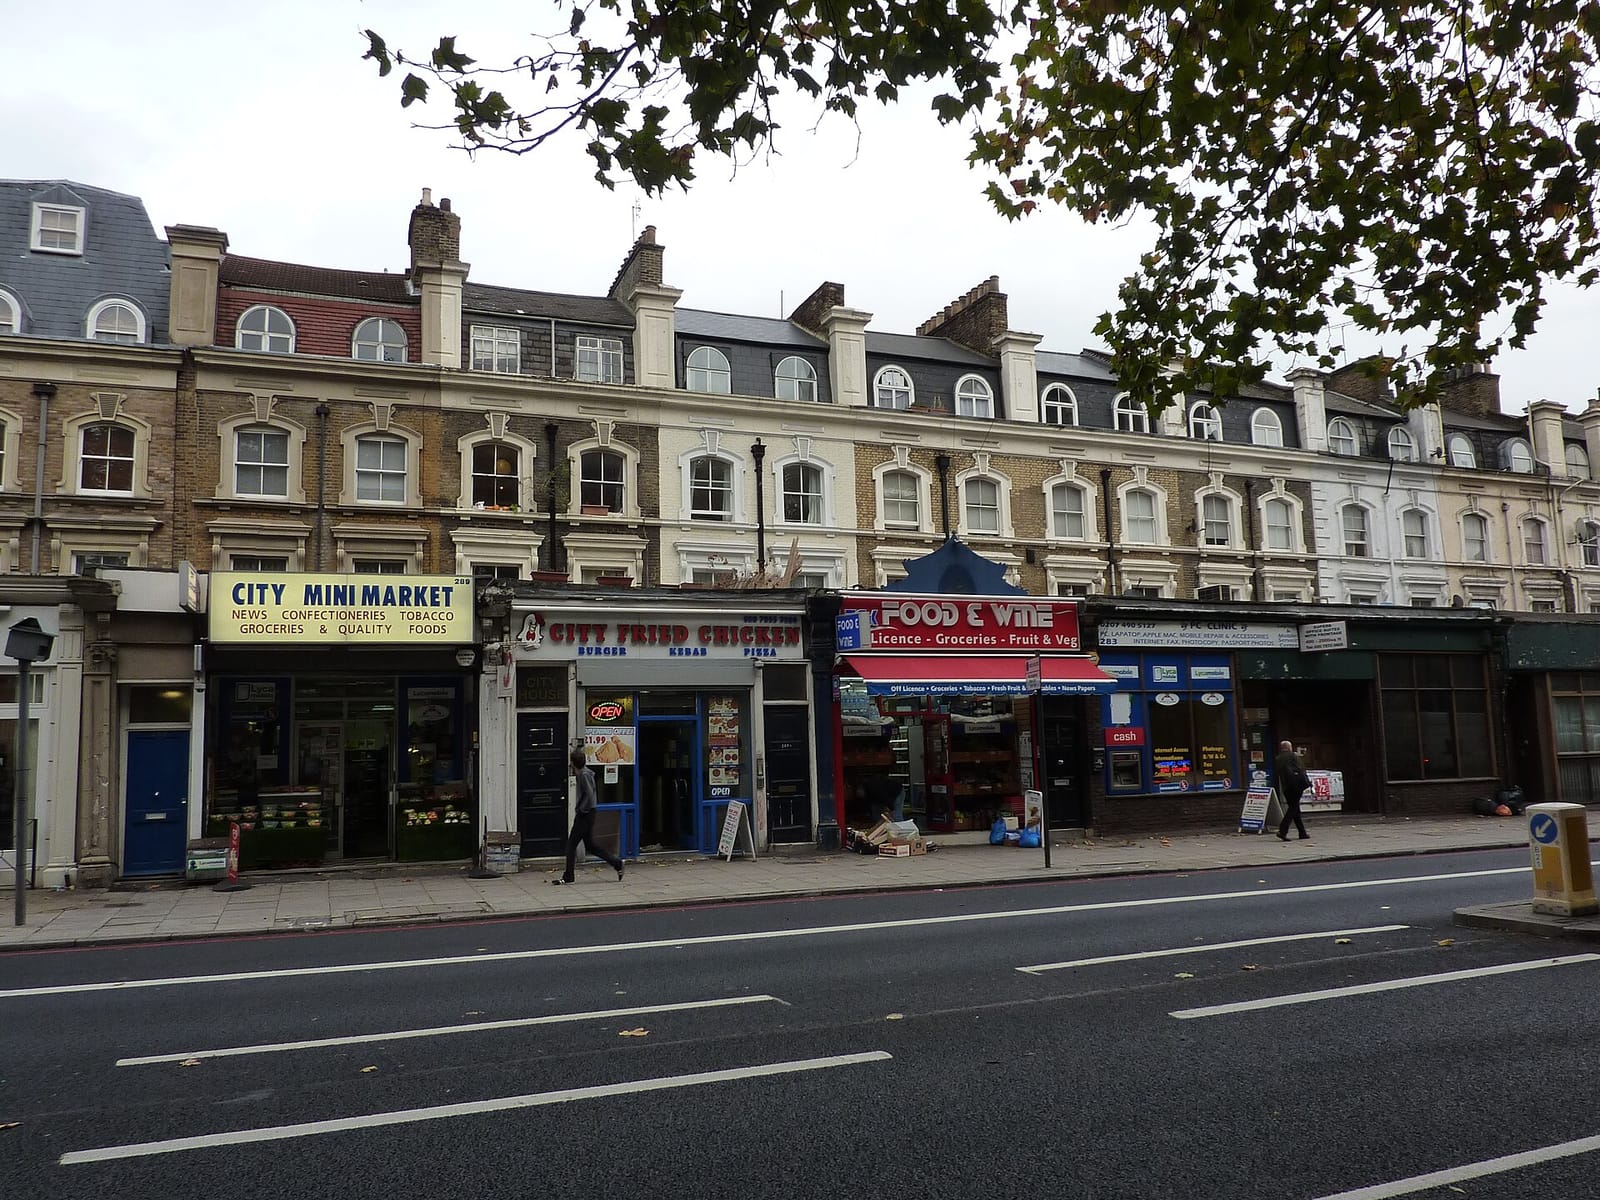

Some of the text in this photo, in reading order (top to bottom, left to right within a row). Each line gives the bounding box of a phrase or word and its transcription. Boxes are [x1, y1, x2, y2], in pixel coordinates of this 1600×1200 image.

[231, 582, 454, 607] CITY MINI MARKET
[232, 609, 454, 621] NEWS CONFECTIONERIES TOBACCO
[881, 601, 959, 626] FOOD
[240, 623, 447, 635] GROCERIES & QUALITY FOODS
[837, 619, 854, 631] FOOD
[1207, 622, 1238, 630] CLINIC
[549, 623, 801, 645] CITY FRIED CHICKEN
[870, 632, 921, 644] Licence
[935, 633, 997, 644] Groceries
[1009, 634, 1040, 645] Fruit
[1042, 634, 1052, 645] &
[1055, 634, 1078, 648] Veg
[577, 646, 627, 656] BURGER
[669, 647, 707, 657] KEBAB
[743, 647, 777, 657] PIZZA
[591, 706, 622, 717] OPEN
[1113, 731, 1137, 741] cash
[711, 787, 731, 796] OPEN
